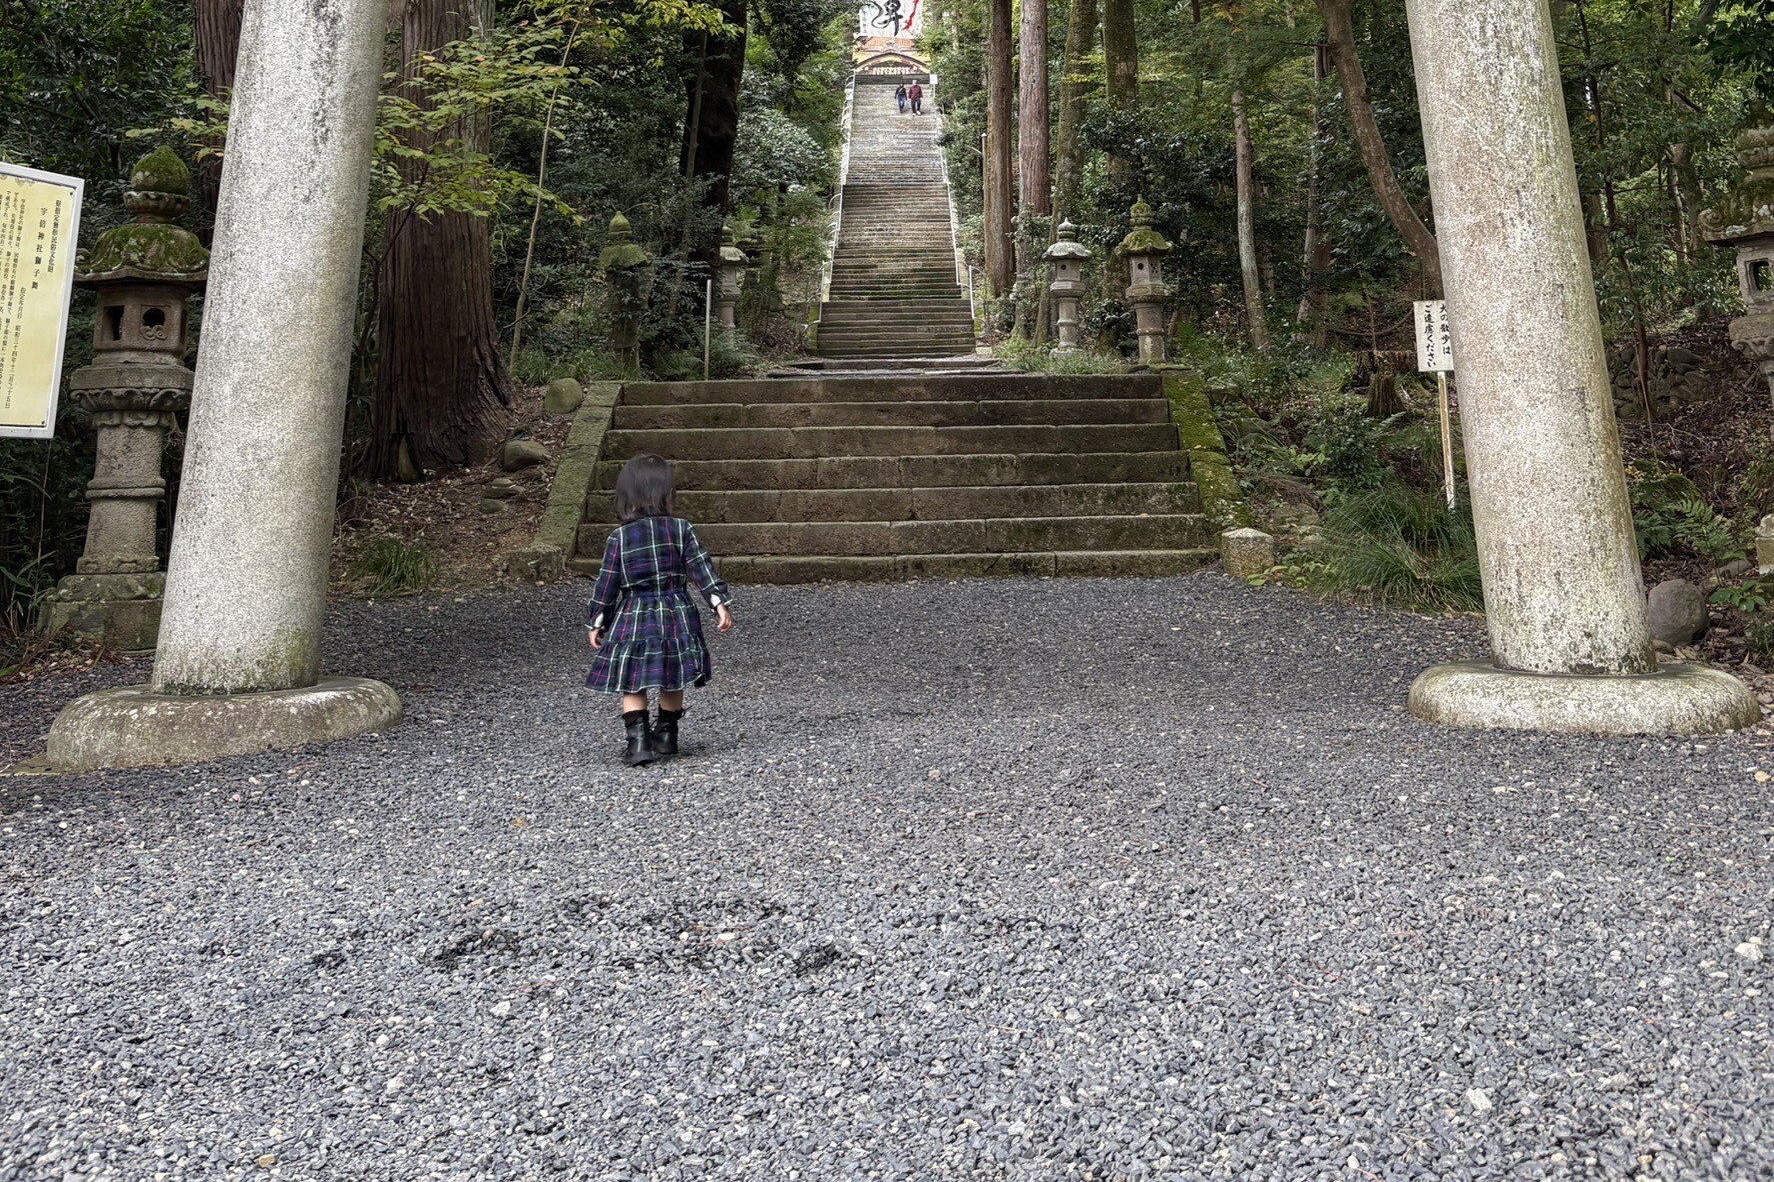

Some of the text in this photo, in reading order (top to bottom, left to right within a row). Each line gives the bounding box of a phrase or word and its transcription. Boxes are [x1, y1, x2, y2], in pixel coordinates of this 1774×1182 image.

[1424, 304, 1436, 368] ご遠慮ください
